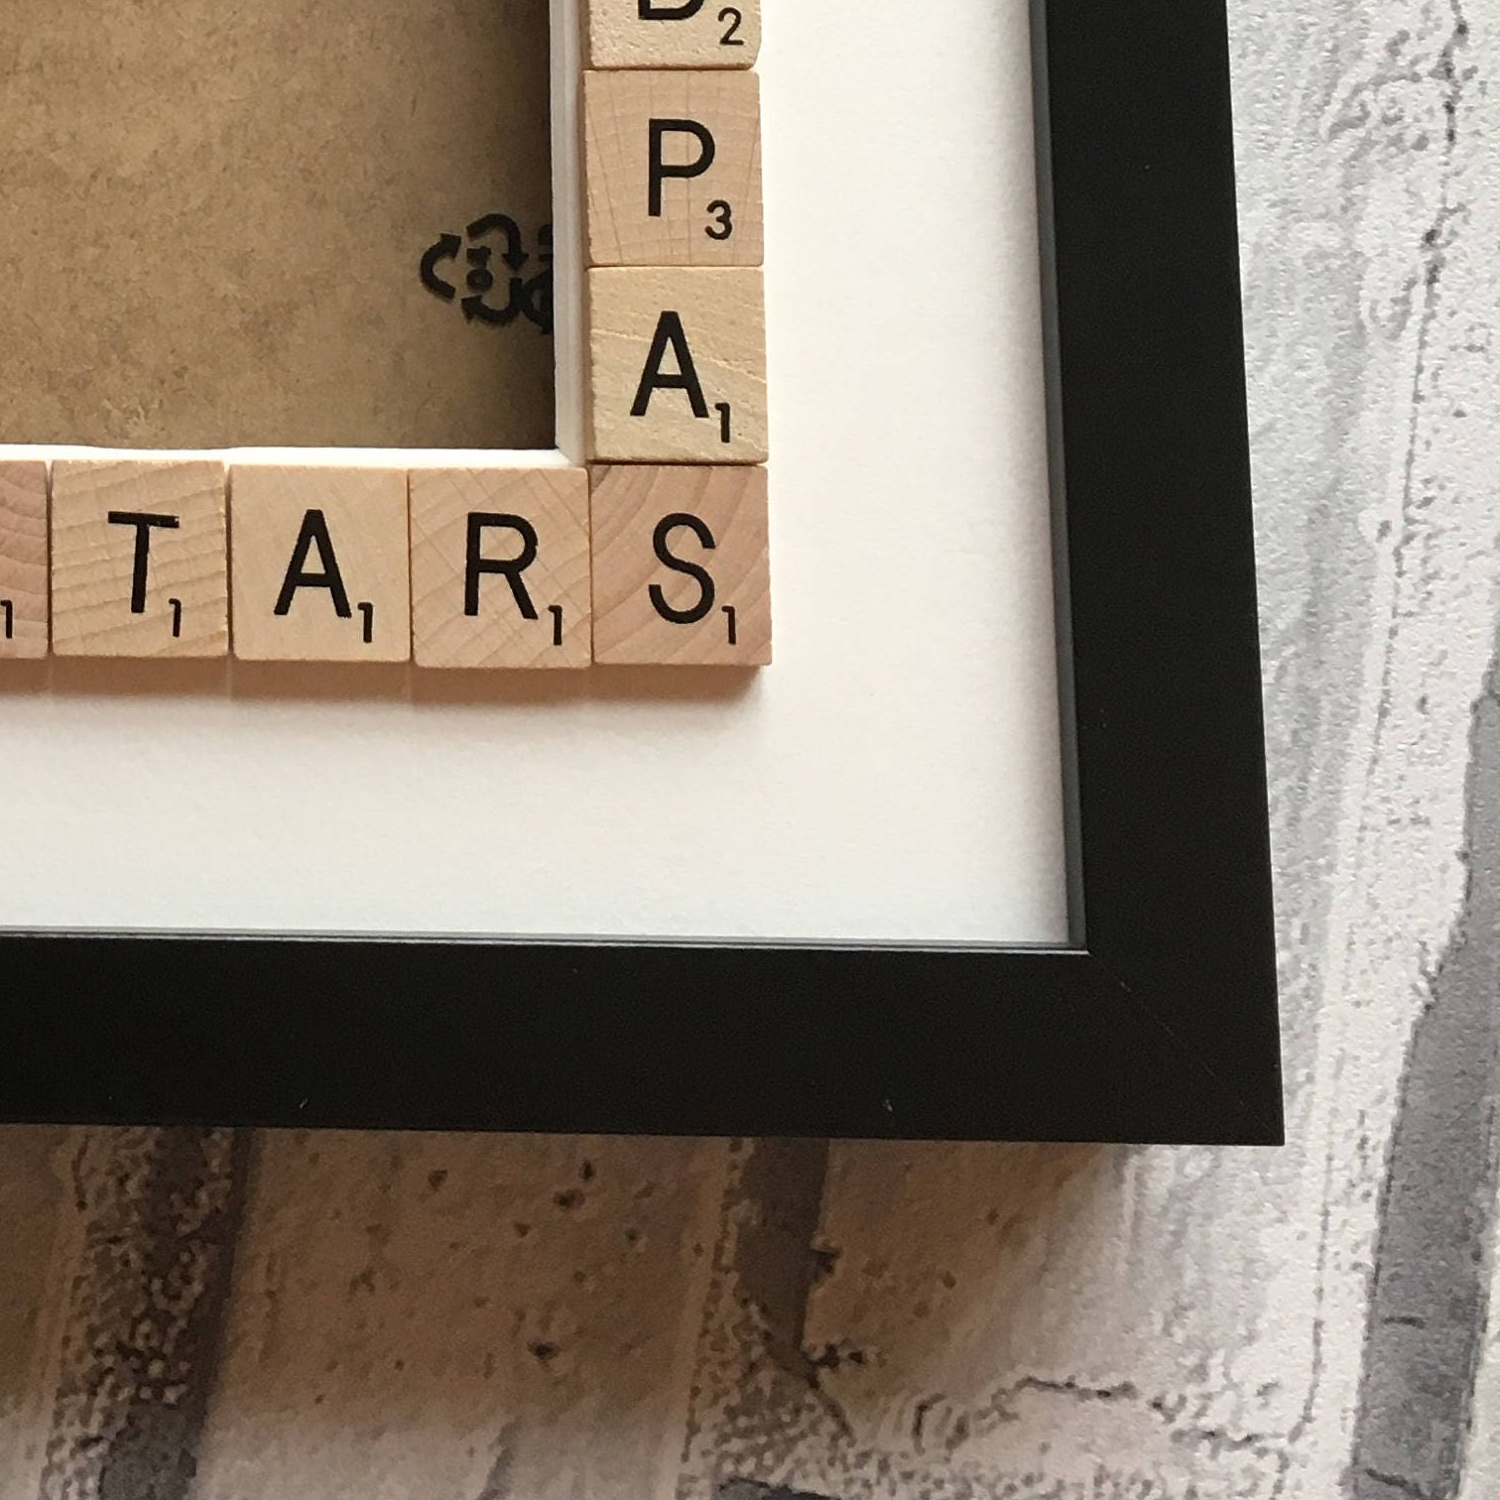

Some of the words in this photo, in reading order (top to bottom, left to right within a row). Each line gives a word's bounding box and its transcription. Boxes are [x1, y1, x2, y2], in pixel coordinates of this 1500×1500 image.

[717, 7, 744, 46] 2
[704, 199, 733, 241] 3
[714, 402, 731, 444] 1
[0, 599, 13, 639] 1
[168, 598, 182, 638] 1
[357, 602, 374, 644] 1
[547, 604, 563, 647] 1
[721, 605, 737, 646] 1
